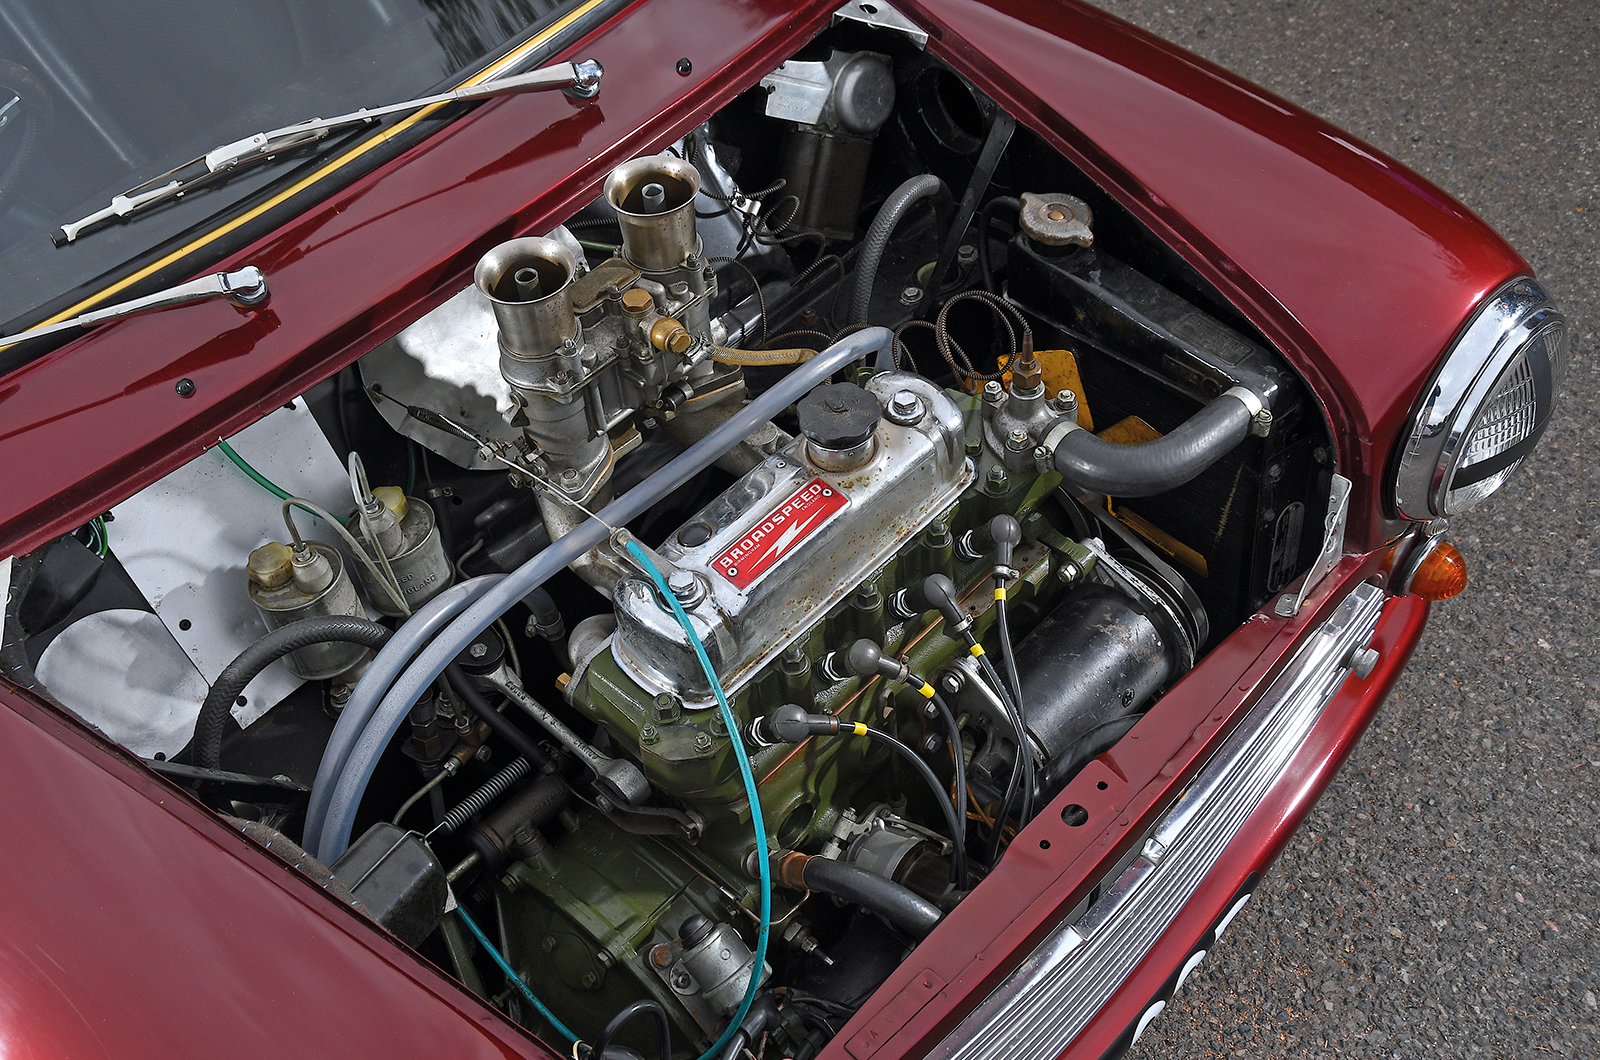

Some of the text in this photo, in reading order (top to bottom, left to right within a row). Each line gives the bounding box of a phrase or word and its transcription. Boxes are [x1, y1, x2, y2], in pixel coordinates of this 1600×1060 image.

[801, 494, 821, 511] ENGLAND
[719, 483, 822, 569] BROADSPEED
[733, 543, 761, 567] BIRMINGHAM
[401, 572, 436, 596] NGLAND
